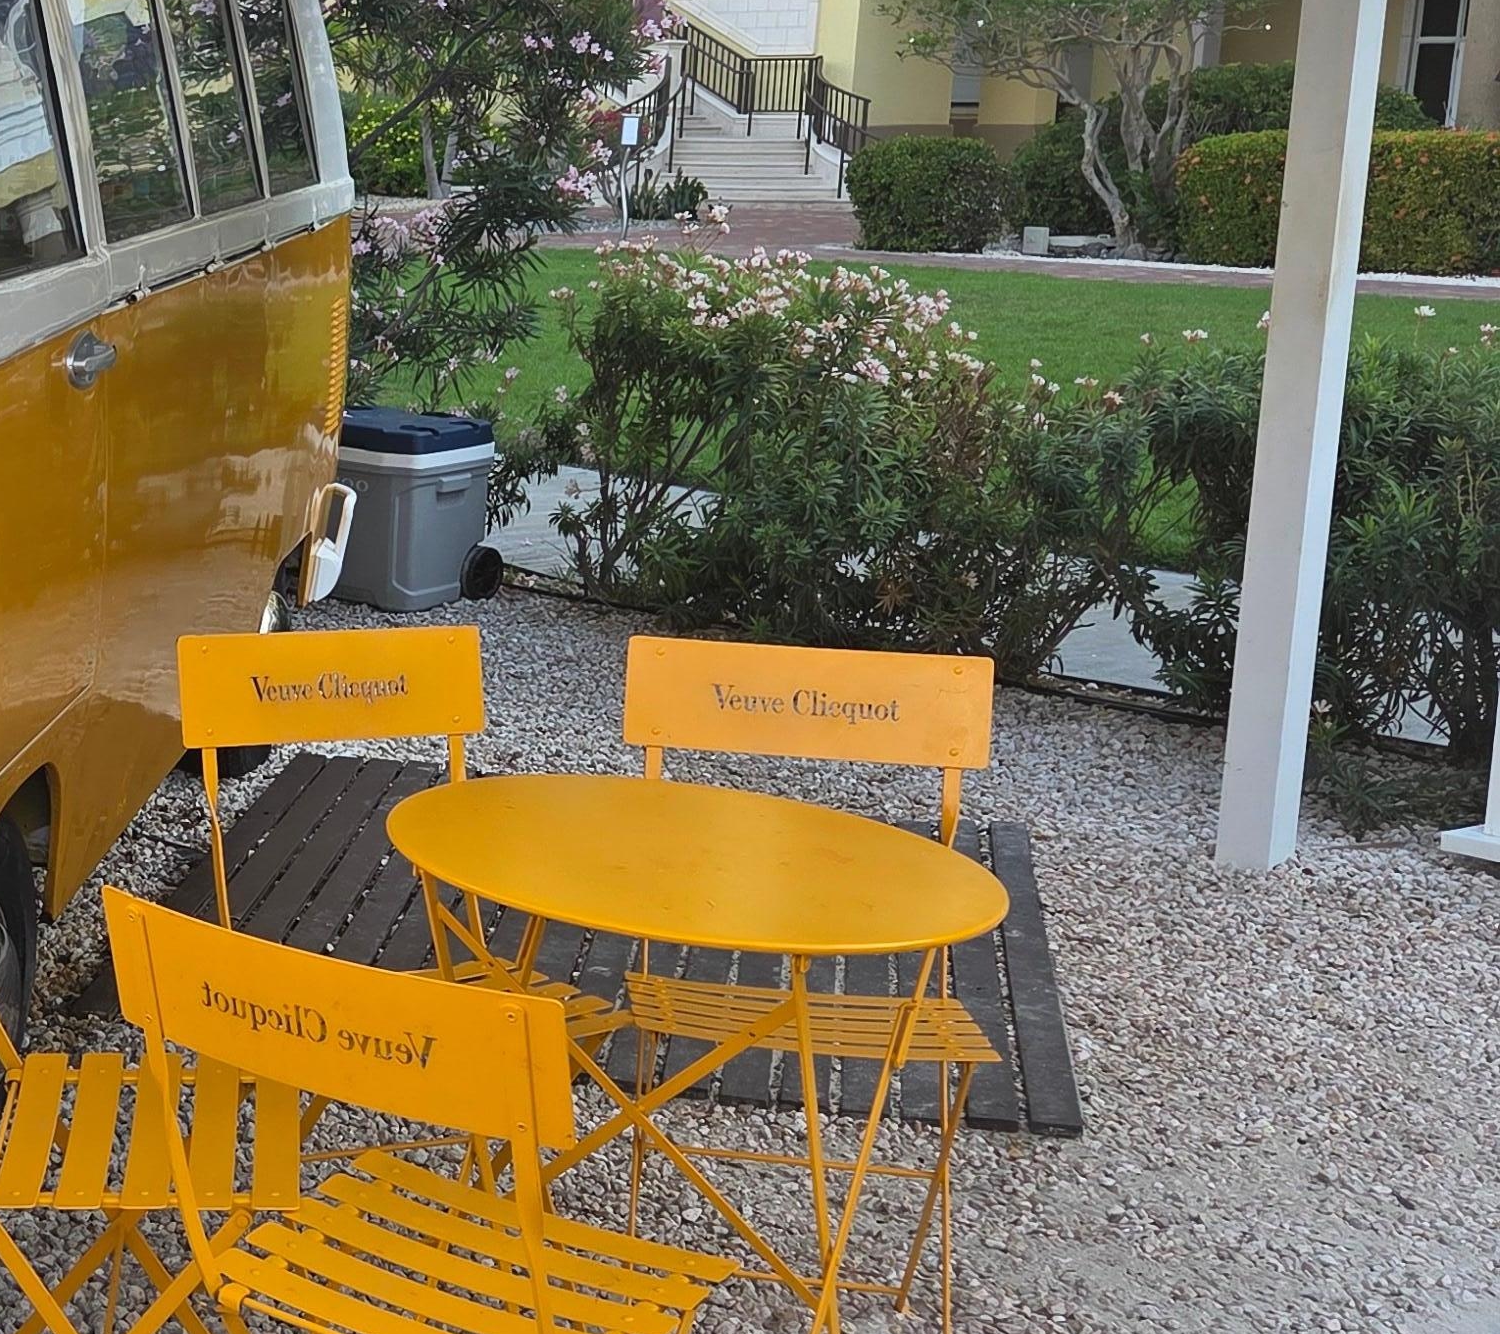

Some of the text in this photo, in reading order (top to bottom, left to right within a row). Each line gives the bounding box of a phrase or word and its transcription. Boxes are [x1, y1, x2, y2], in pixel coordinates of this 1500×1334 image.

[250, 672, 409, 706] Veuve Clicquot
[712, 683, 901, 725] Veuve Clicquot
